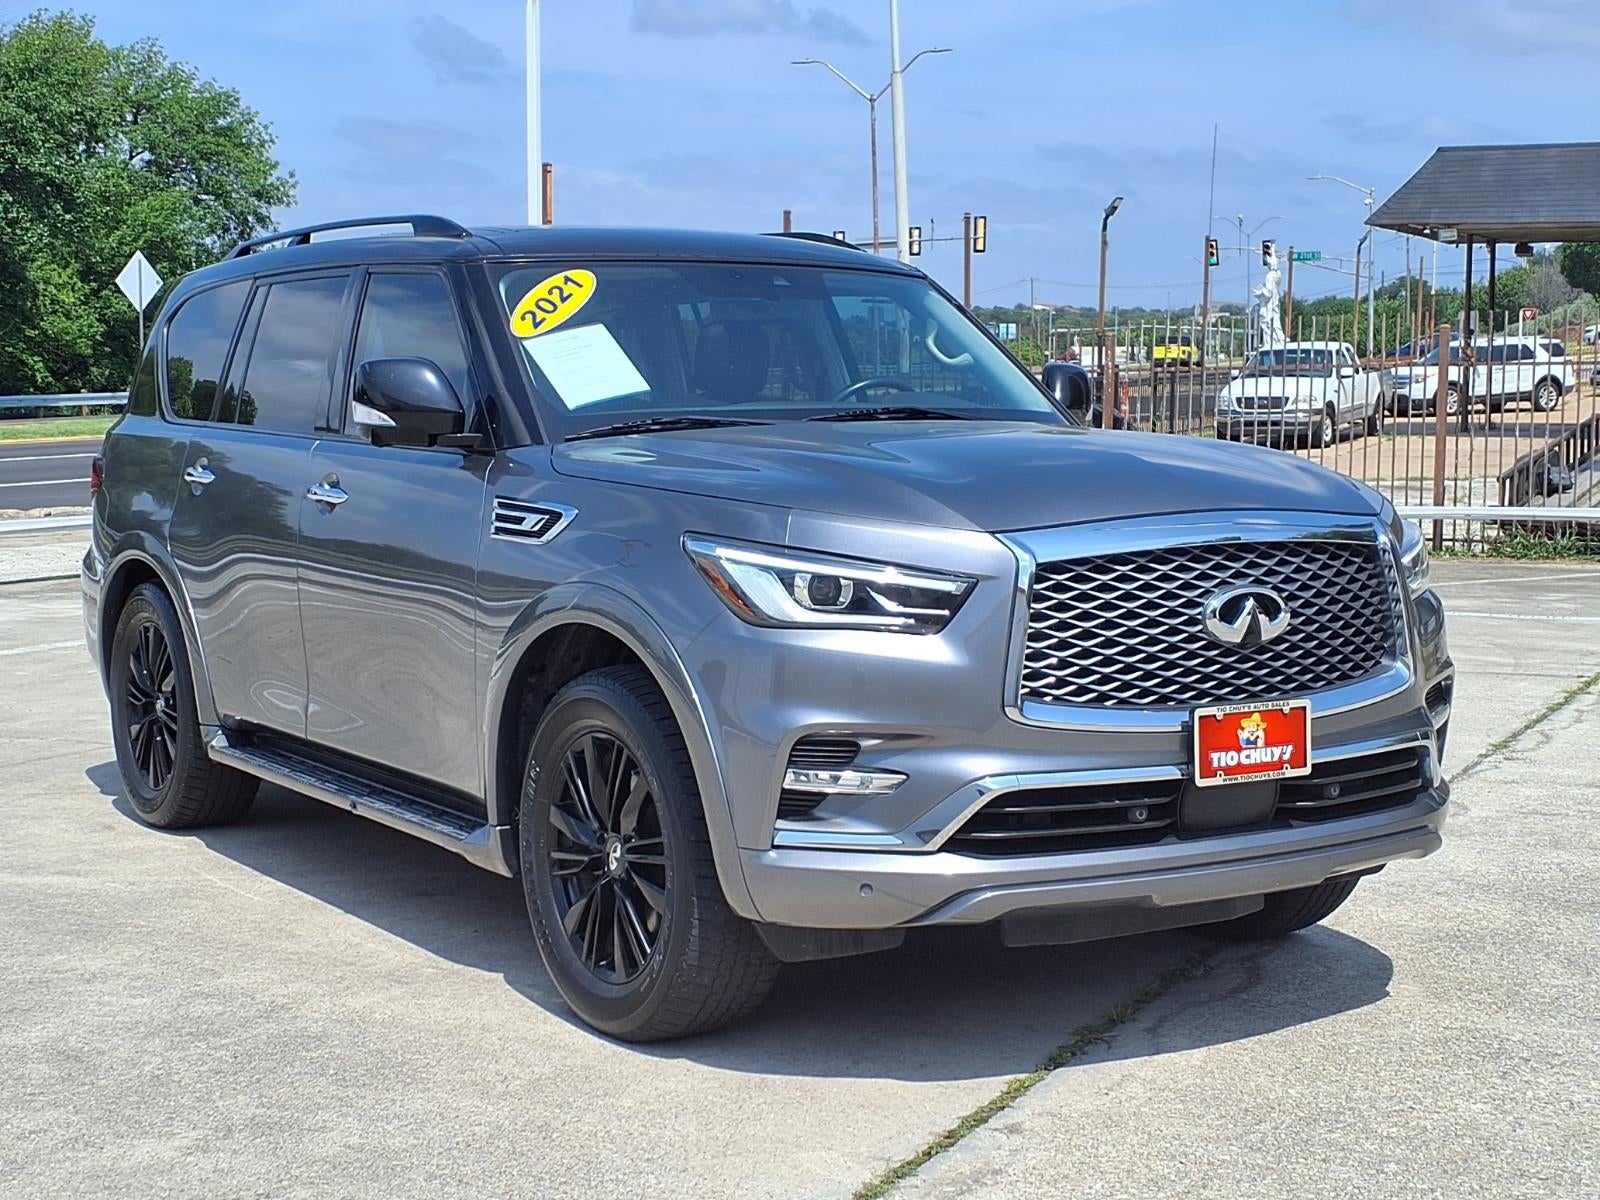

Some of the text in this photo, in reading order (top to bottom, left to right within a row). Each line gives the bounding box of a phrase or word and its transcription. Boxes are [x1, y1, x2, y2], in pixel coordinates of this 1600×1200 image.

[520, 275, 584, 330] 2021
[1228, 704, 1252, 712] CHUY'S
[1210, 744, 1294, 768] TIO CHUY'S
[1222, 771, 1286, 784] WWW.TIOCHUYS.COM
